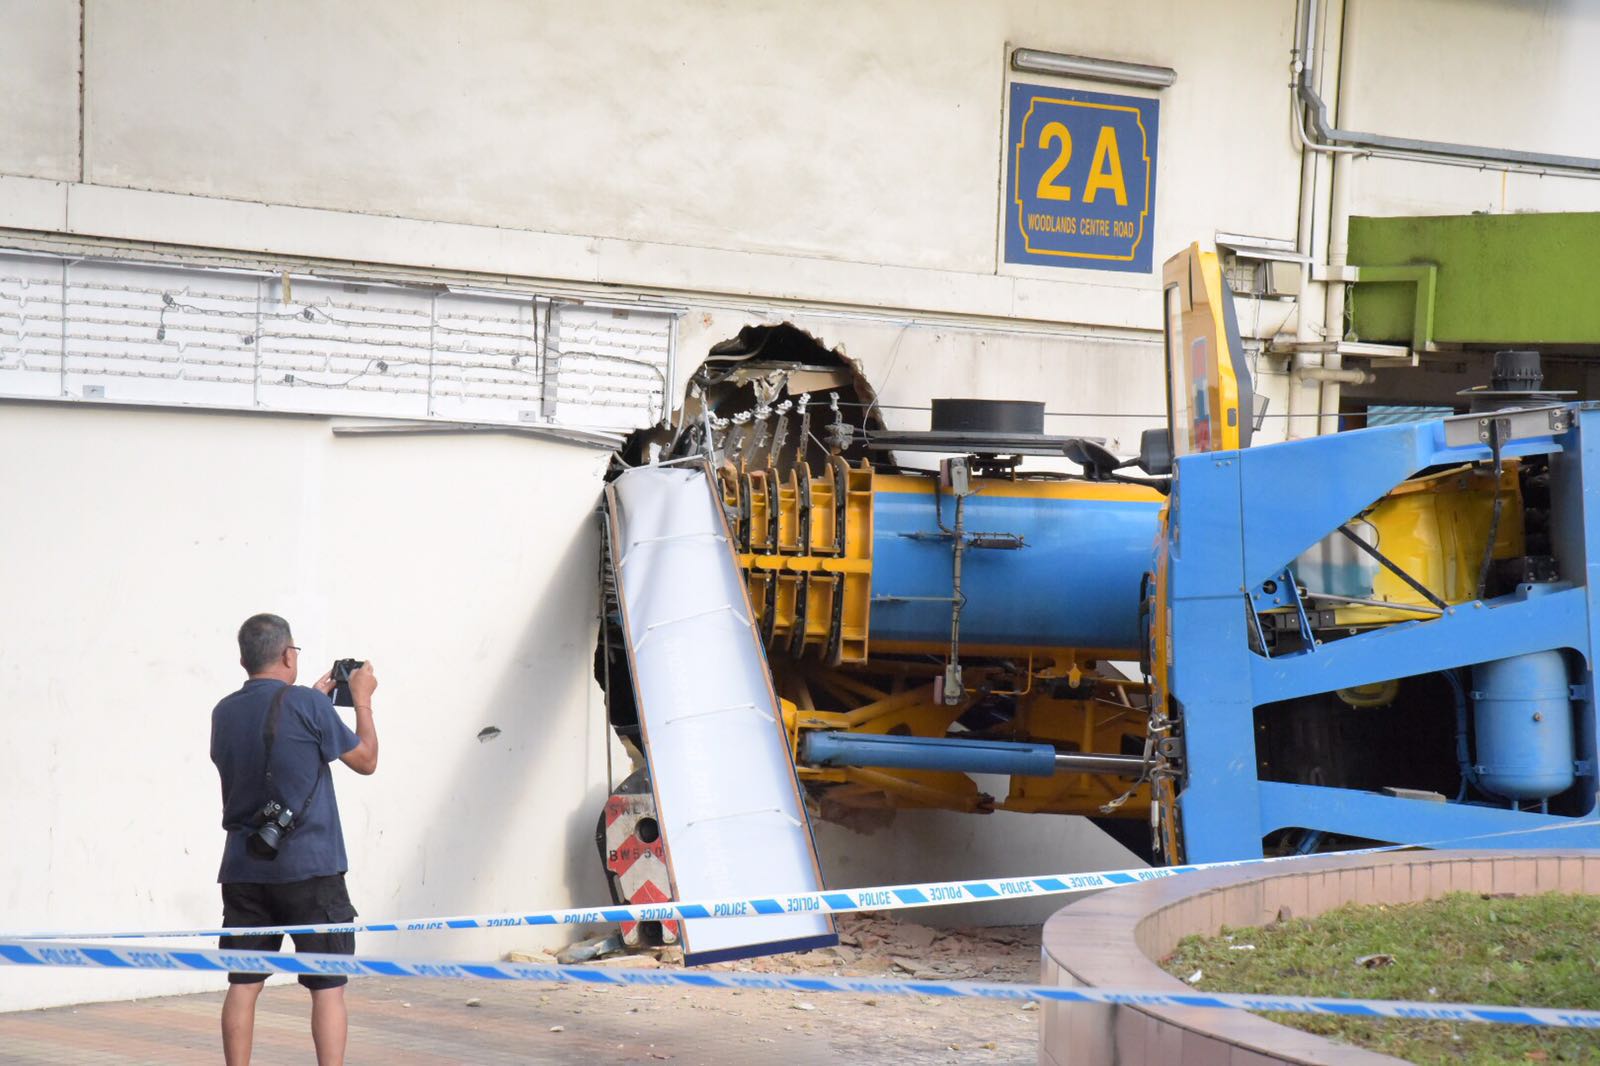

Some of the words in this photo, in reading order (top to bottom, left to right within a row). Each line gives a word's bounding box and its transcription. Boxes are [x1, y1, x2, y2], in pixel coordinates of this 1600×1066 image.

[1027, 213, 1077, 234] WOODLANDS
[1080, 218, 1110, 237] CENTRE
[1113, 221, 1134, 239] ROAD
[1000, 880, 1033, 895] POLICE
[1071, 875, 1103, 889] POLICE
[859, 891, 891, 907] POLICE
[930, 886, 962, 901] POLICE
[714, 902, 747, 916] POLICE
[788, 897, 820, 912] POLICE
[640, 907, 673, 920] POLICE
